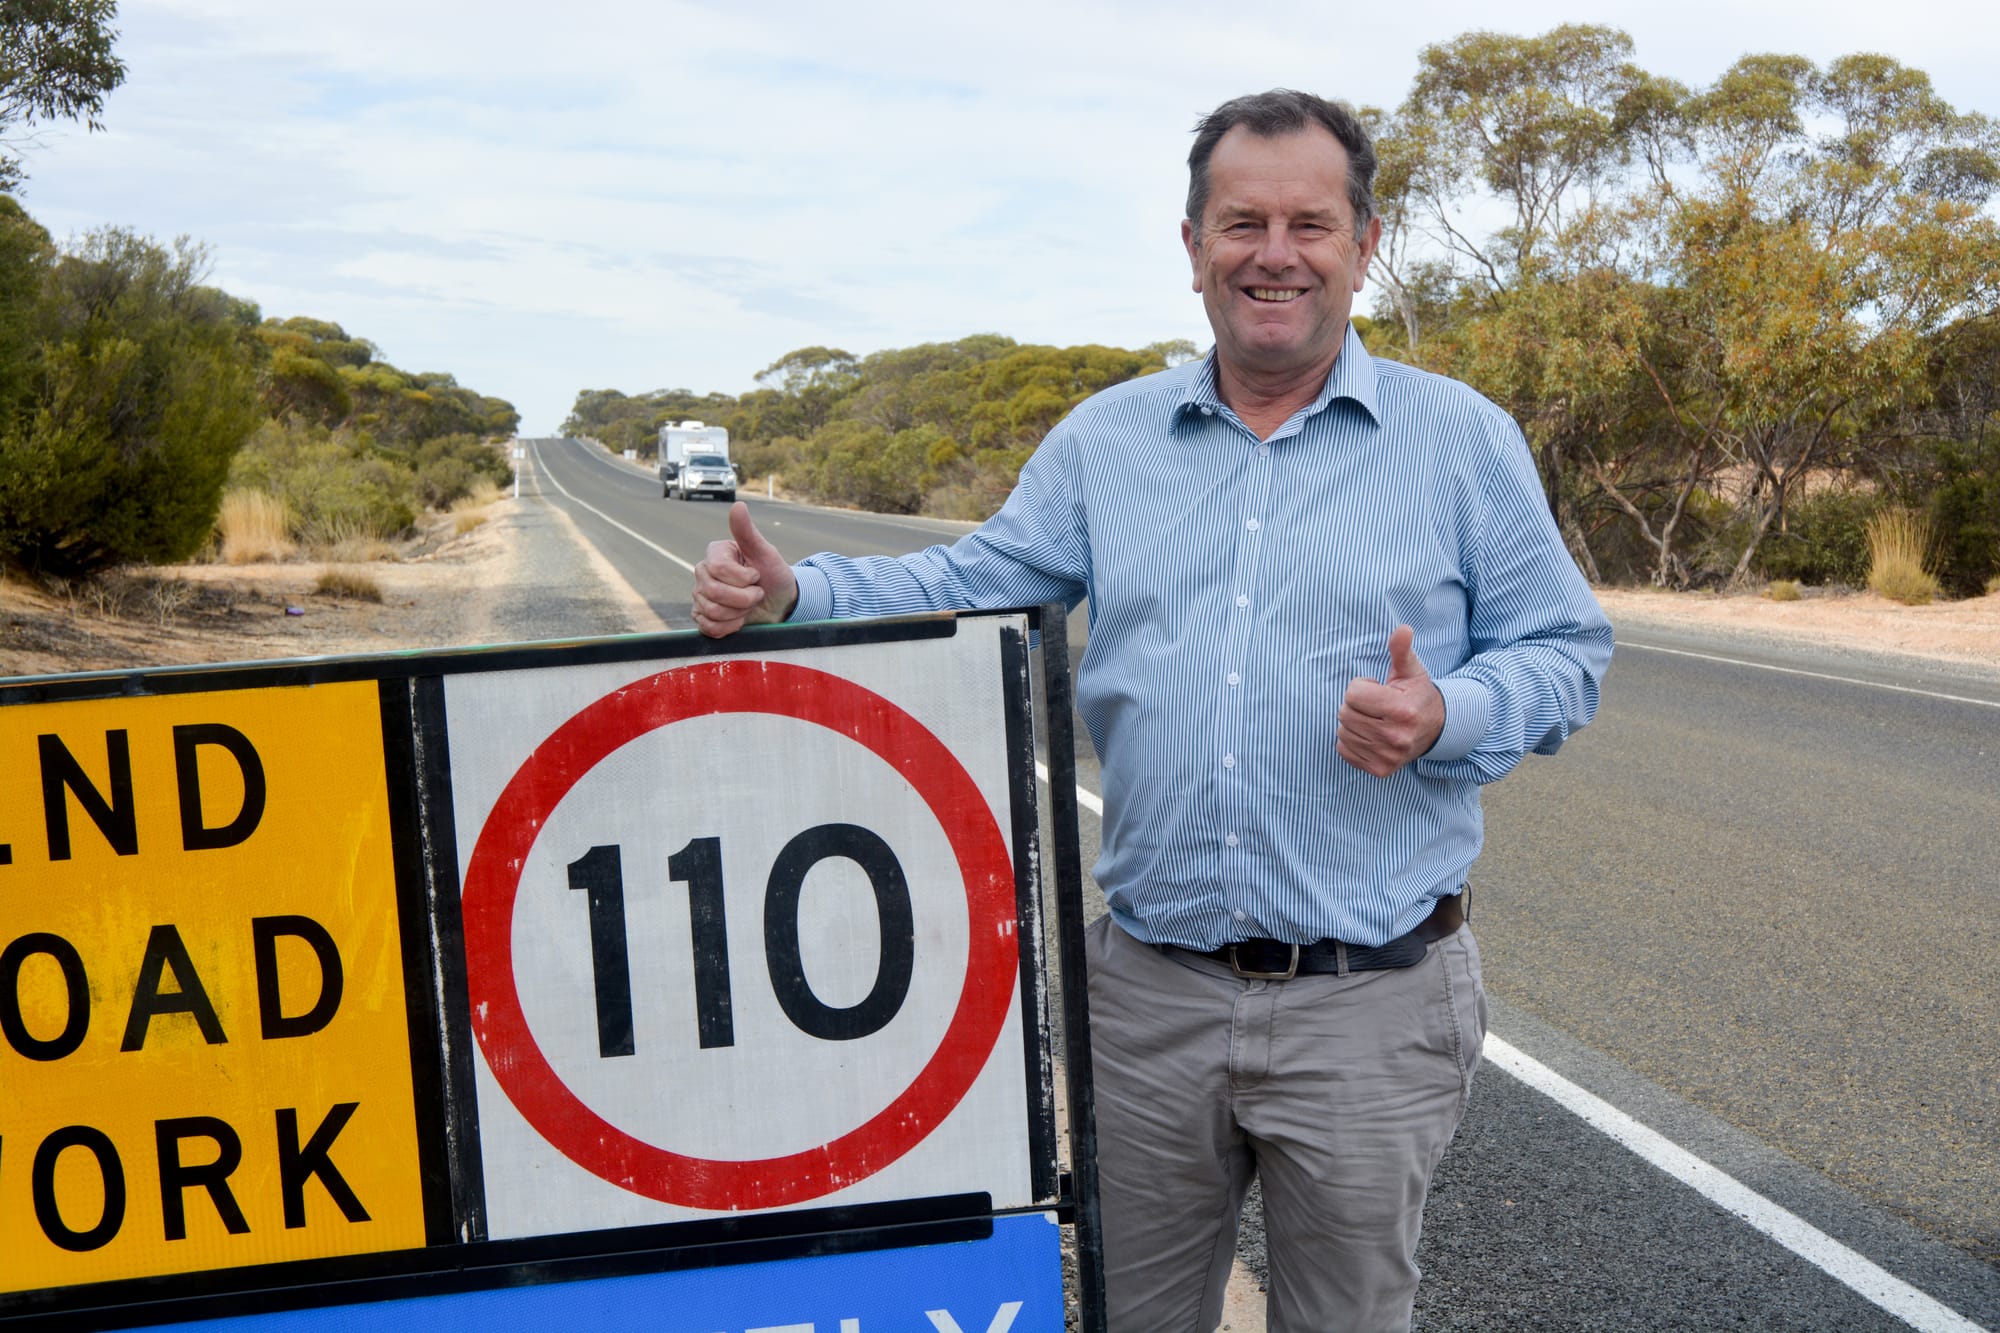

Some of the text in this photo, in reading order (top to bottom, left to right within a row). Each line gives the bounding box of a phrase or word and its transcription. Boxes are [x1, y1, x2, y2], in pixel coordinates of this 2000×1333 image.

[0, 723, 266, 864] ND
[567, 823, 914, 1058] 110
[0, 1102, 372, 1252] ORK
